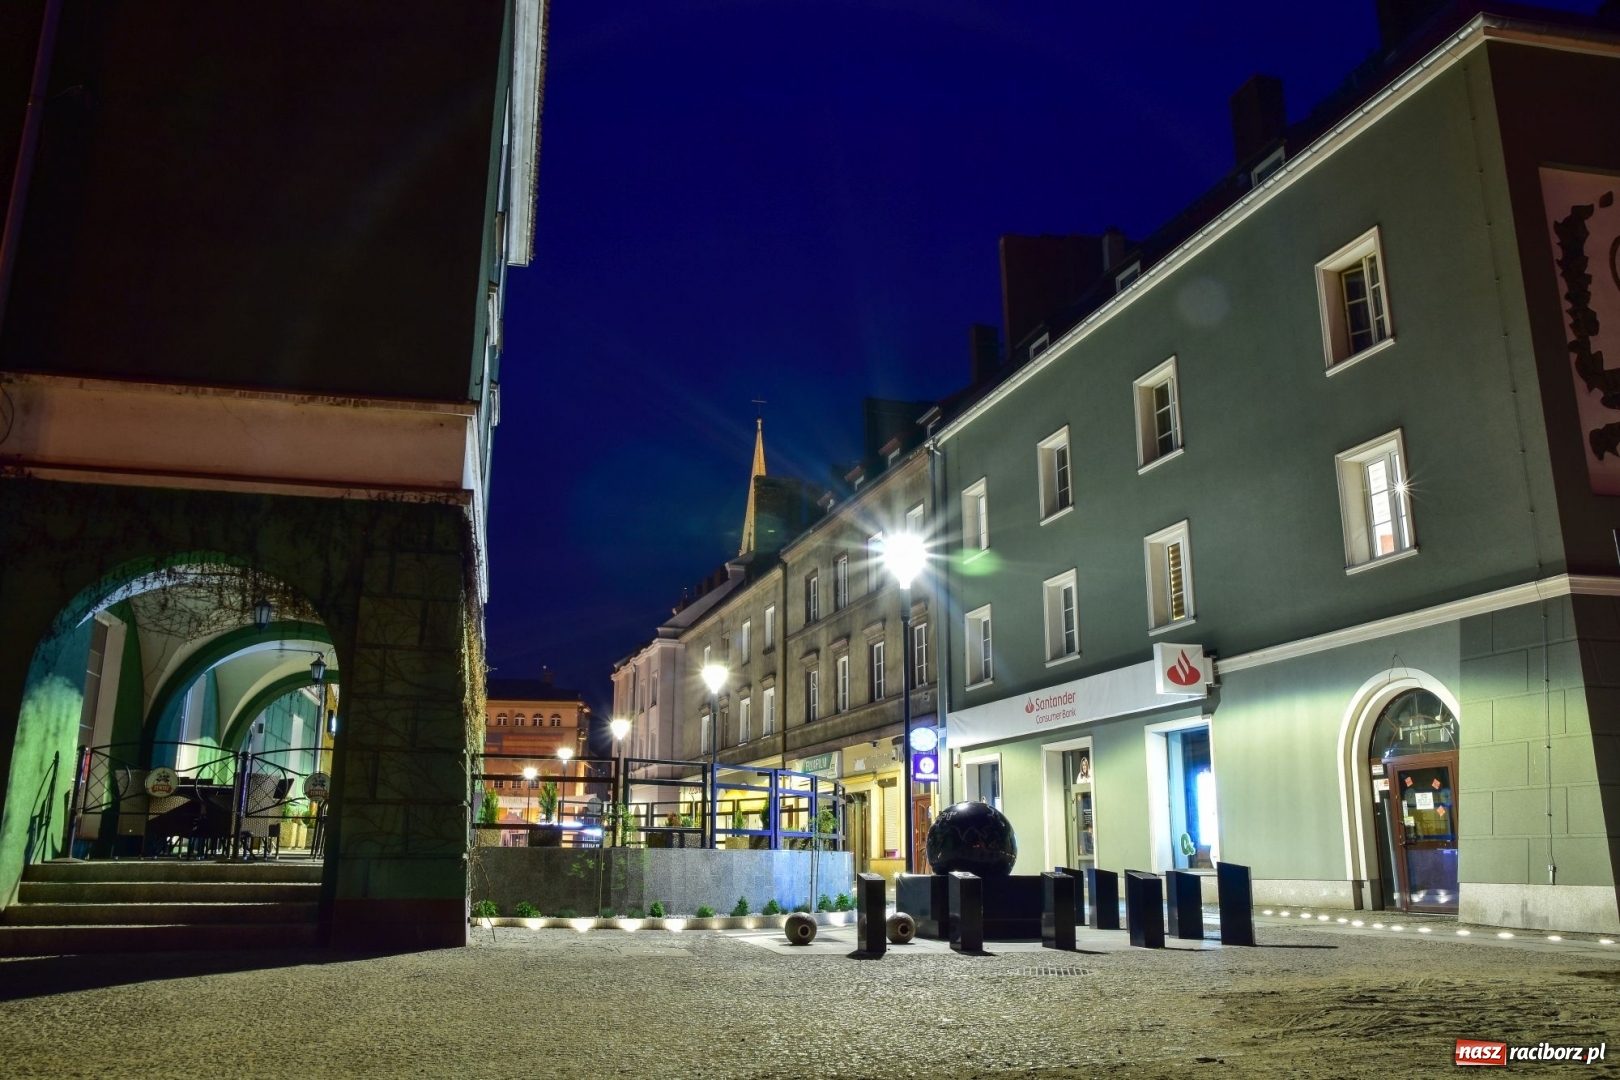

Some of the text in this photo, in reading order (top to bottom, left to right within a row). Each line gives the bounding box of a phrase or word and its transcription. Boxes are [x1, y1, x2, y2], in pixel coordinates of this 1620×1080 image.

[1035, 691, 1076, 711] Santander
[1036, 708, 1076, 724] Consumer Bank
